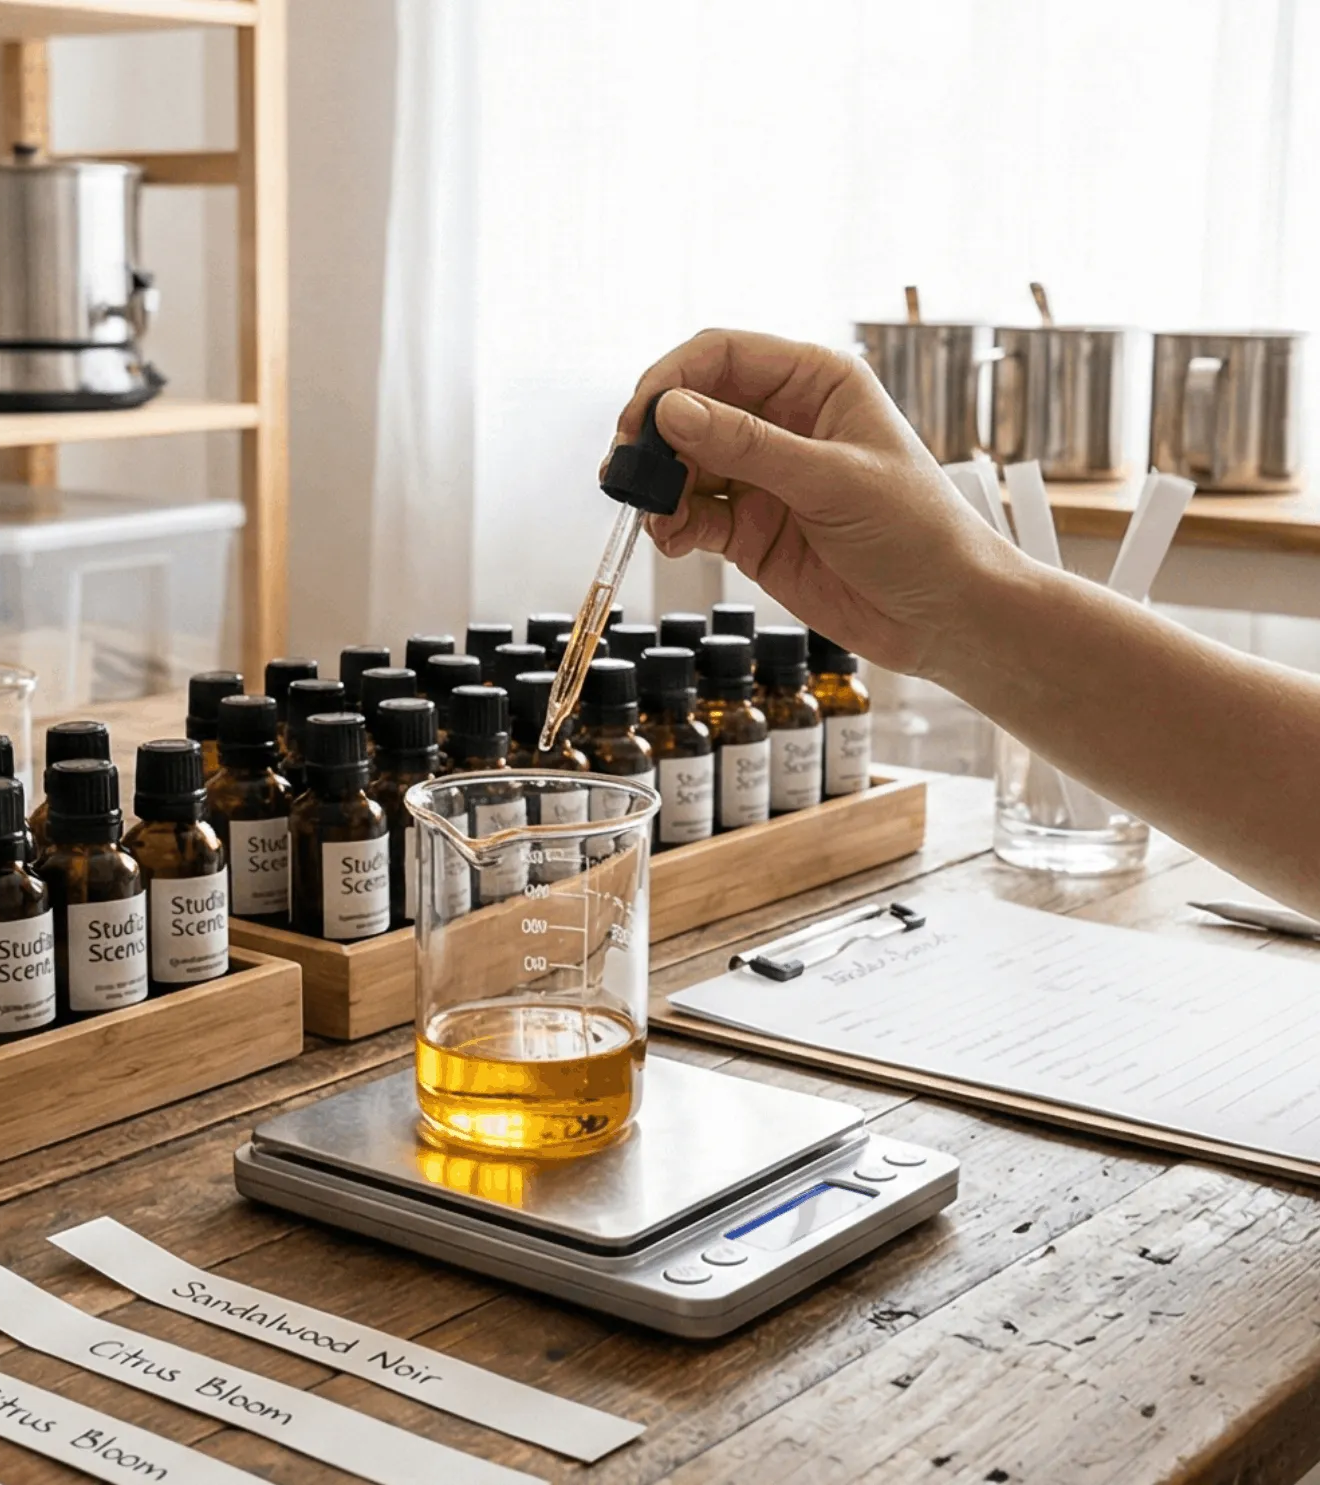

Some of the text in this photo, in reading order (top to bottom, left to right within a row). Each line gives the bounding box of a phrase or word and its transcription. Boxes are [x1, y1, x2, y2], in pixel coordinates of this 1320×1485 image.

[171, 1280, 444, 1384] Sandalwood Noir
[88, 1339, 293, 1426] Citrus Bloom
[69, 1428, 168, 1481] Bloom
